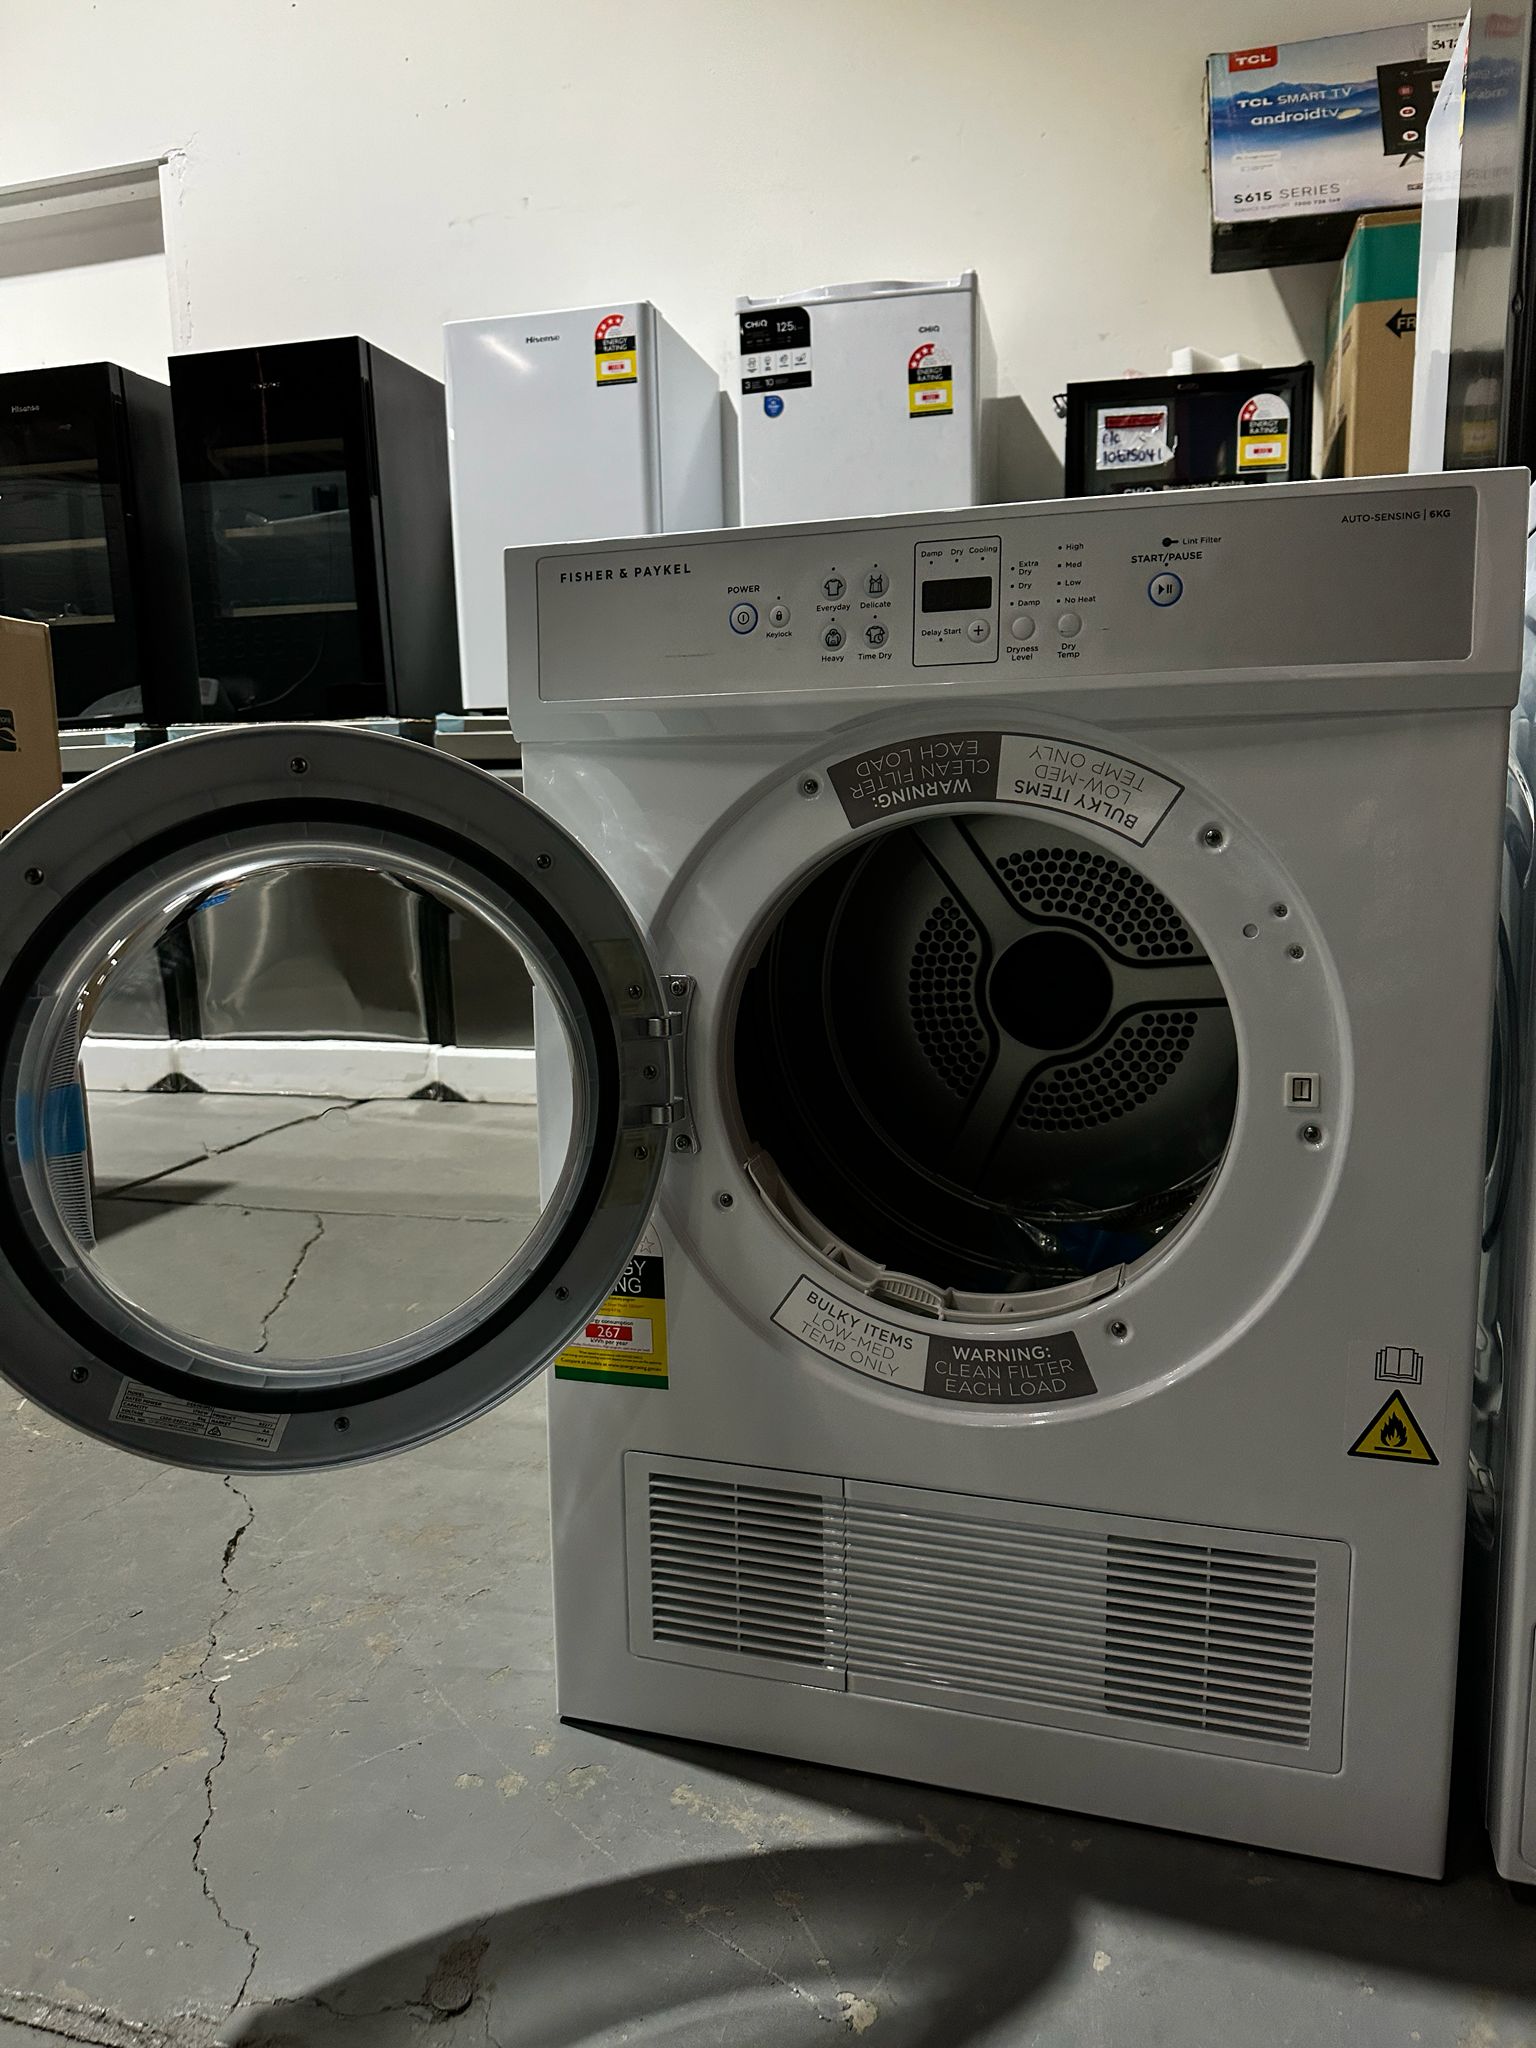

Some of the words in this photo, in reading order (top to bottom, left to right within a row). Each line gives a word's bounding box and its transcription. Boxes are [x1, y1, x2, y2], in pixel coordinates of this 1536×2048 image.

[1235, 54, 1272, 66] TCL
[1236, 98, 1273, 109] TCL
[1277, 90, 1326, 105] SMART
[1329, 86, 1352, 98] TV
[1250, 107, 1340, 126] androidtv
[1234, 190, 1273, 203] S615
[1279, 183, 1341, 199] SERIES
[1397, 317, 1416, 329] FR
[526, 334, 560, 344] Hisense
[603, 337, 628, 346] ENERGY
[603, 343, 628, 352] RATING
[916, 367, 943, 376] ENERGY
[917, 373, 944, 382] RATING
[1249, 419, 1279, 428] ENERGY
[1249, 426, 1279, 435] RATING
[1341, 511, 1421, 524] AUTO-SENSING
[1429, 509, 1451, 519] 6KG
[1182, 536, 1198, 546] Lint
[1200, 535, 1222, 545] Filter
[950, 548, 964, 556] Dry
[968, 545, 998, 555] Cooling
[1066, 543, 1084, 551] High
[921, 550, 943, 559] Damp
[1131, 551, 1203, 564] START/PAUSE
[1018, 560, 1039, 568] Extra
[560, 569, 613, 583] FISHER
[619, 568, 628, 578] &
[634, 563, 691, 578] PAYKEL
[1018, 568, 1032, 576] Dry
[1018, 582, 1032, 590] Dry
[1065, 579, 1082, 587] Low
[727, 584, 760, 595] POWER
[1018, 599, 1041, 608] Damp
[1064, 596, 1076, 604] No
[1078, 595, 1096, 603] Heat
[816, 603, 851, 613] Everyday
[860, 601, 891, 610] Delicate
[766, 630, 793, 639] Keylock
[921, 629, 942, 638] Delay
[943, 627, 962, 635] Start
[1006, 645, 1039, 654] Dryness
[1061, 643, 1076, 651] Dry
[821, 655, 845, 663] Heavy
[858, 653, 877, 661] Time
[878, 652, 893, 661] Dry
[1011, 653, 1033, 661] Level
[1057, 651, 1080, 659] Temp
[920, 740, 978, 760] EACH
[1029, 745, 1086, 768] ONLY
[856, 748, 913, 777] LOAD
[920, 758, 990, 779] CLEAN
[1091, 761, 1145, 792] TEMP
[849, 767, 914, 799] FILTER
[1034, 764, 1132, 805] LOW-MED
[872, 778, 972, 808] WARNING:
[1014, 780, 1070, 803] ITEMS
[1074, 793, 1139, 829] BULKY
[601, 1319, 634, 1327] consumption
[807, 1291, 860, 1328] BULKY
[864, 1322, 914, 1350] ITEMS
[597, 1325, 621, 1339] 267
[812, 1312, 896, 1359] LOW-MED
[800, 1321, 846, 1354] TEMP
[850, 1351, 900, 1377] ONLY
[952, 1345, 1051, 1361] WARNING:
[934, 1360, 1001, 1380] CLEAN
[1008, 1358, 1074, 1379] FILTER
[945, 1378, 1001, 1396] EACH
[1009, 1378, 1067, 1397] LOAD
[123, 1402, 149, 1411] CAPACITY
